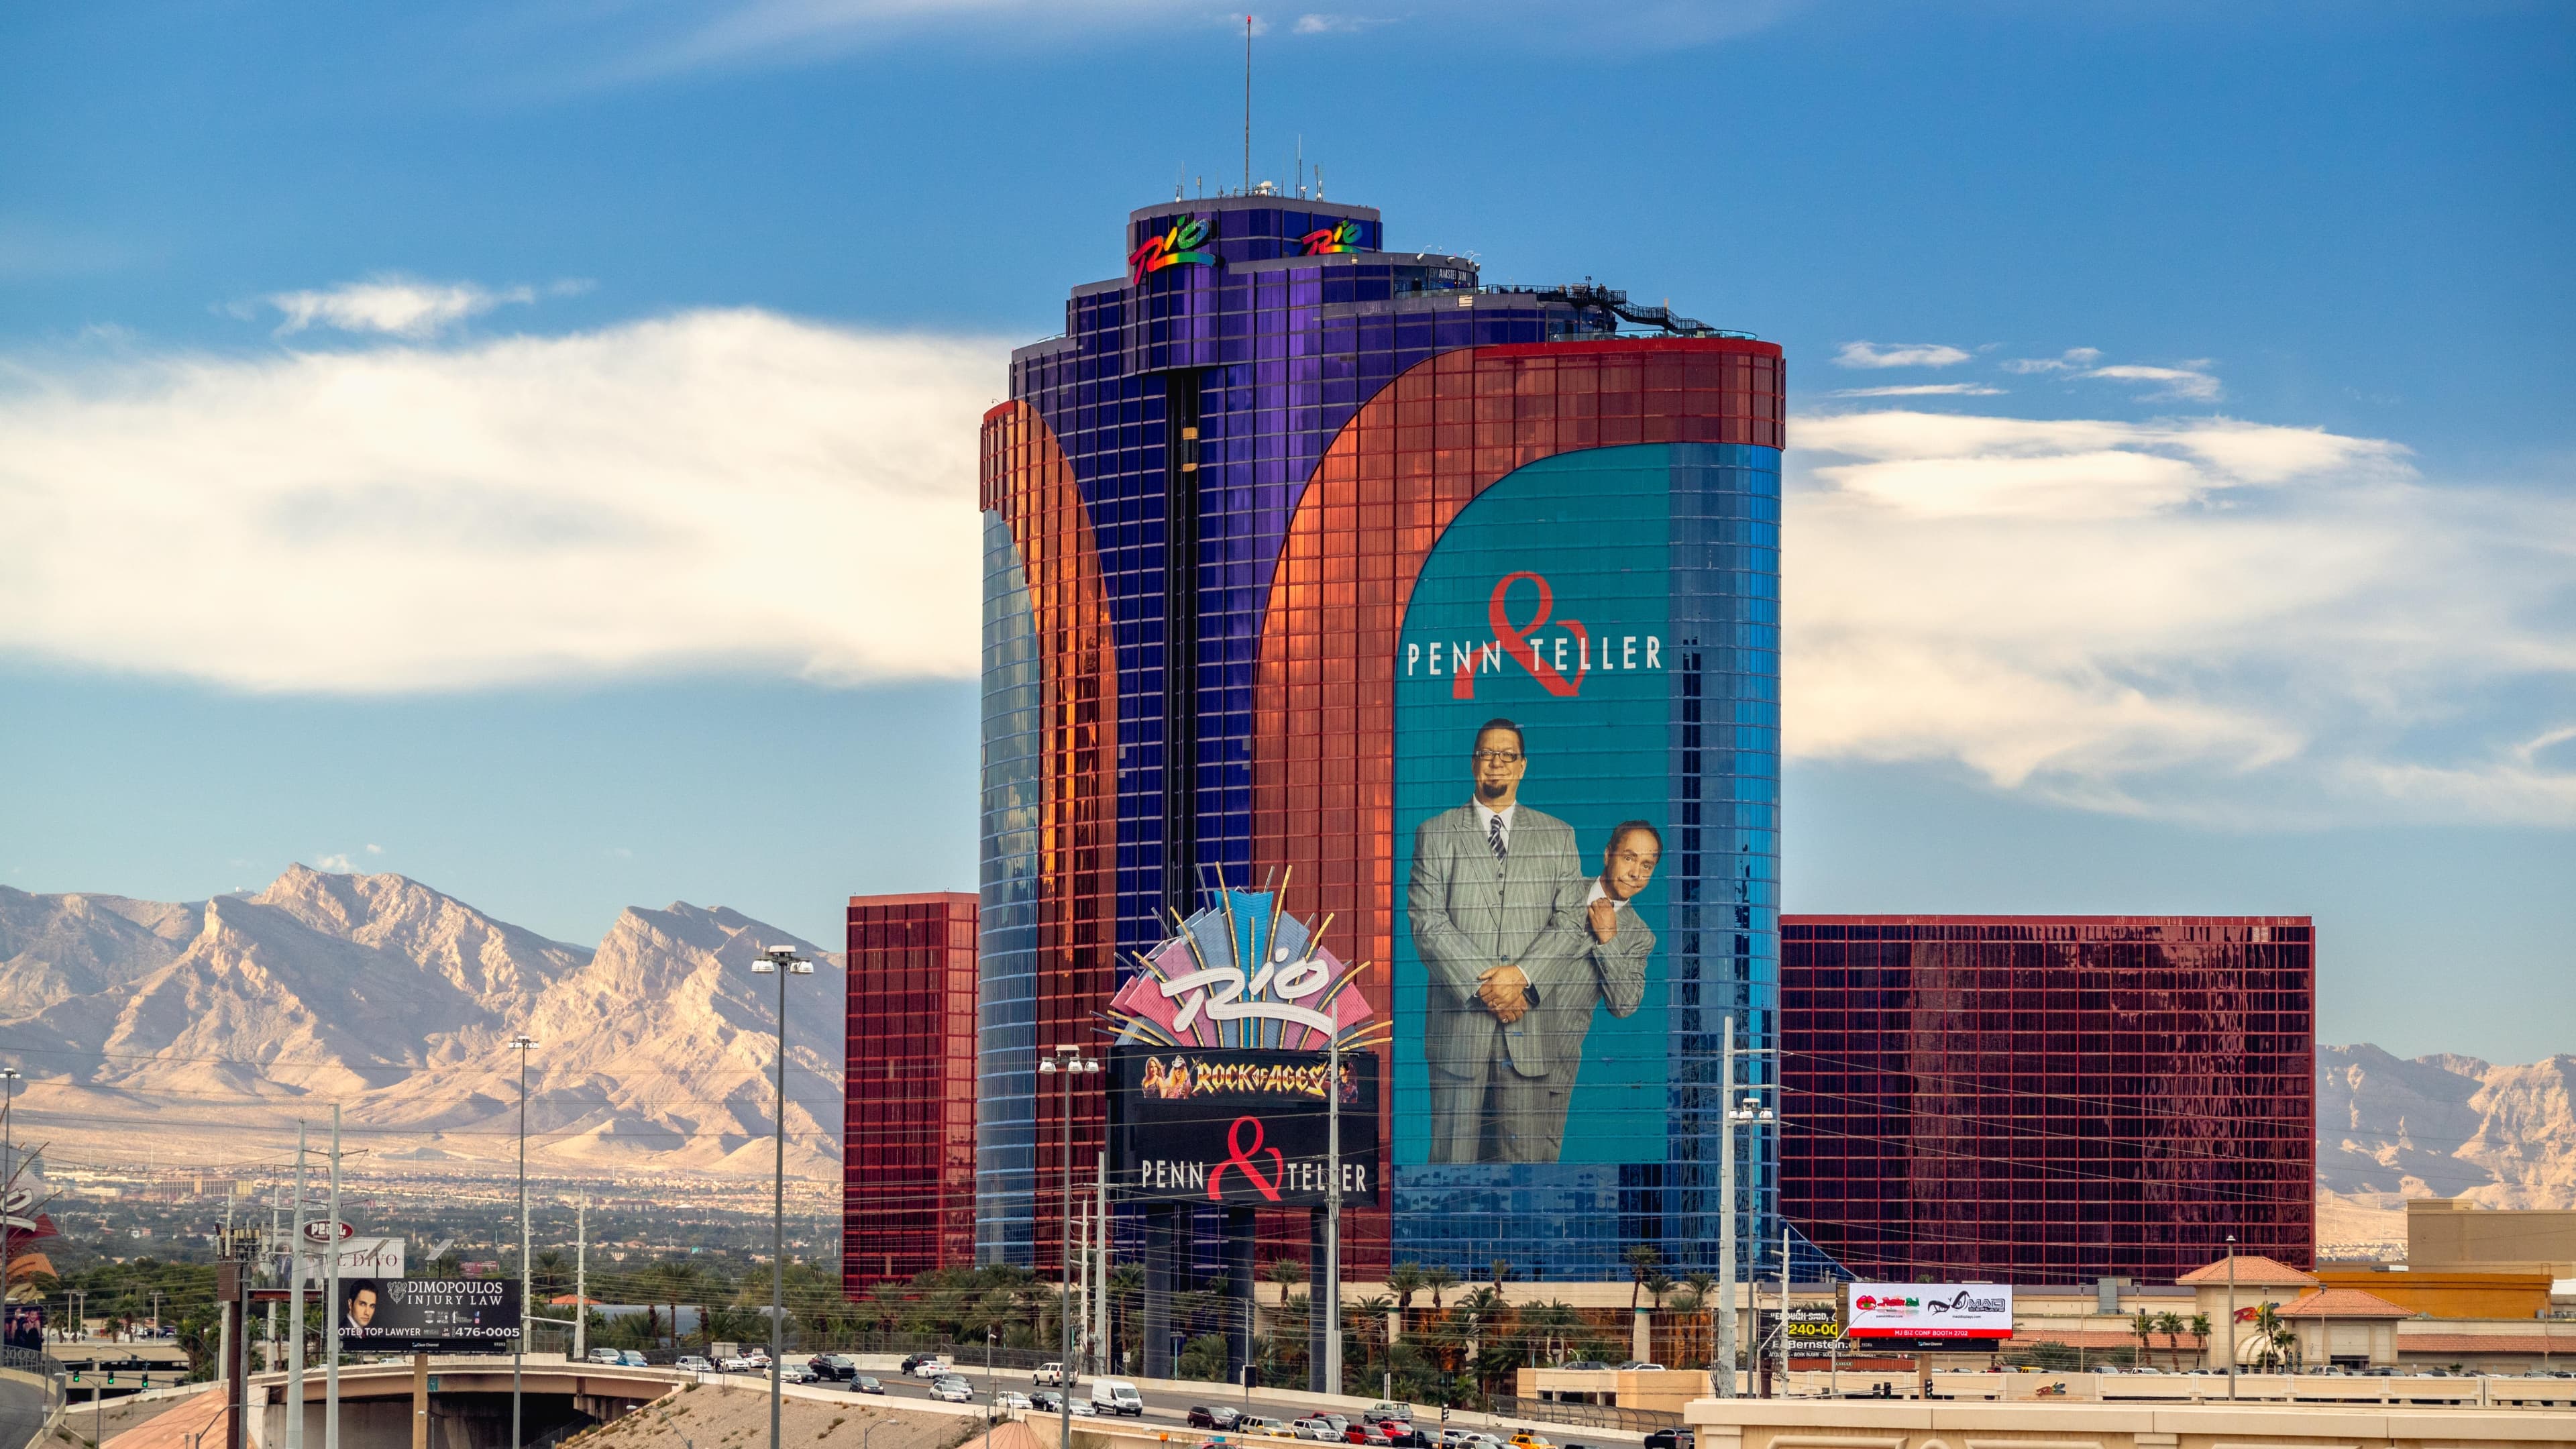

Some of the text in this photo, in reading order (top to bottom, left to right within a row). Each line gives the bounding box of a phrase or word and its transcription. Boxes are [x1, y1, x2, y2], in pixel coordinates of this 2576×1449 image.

[1129, 215, 1216, 285] Rio
[1302, 219, 1363, 256] Rio
[1407, 639, 1501, 676] PENN
[1529, 635, 1662, 671] TELLER
[1159, 947, 1332, 1036] Rio
[1191, 1059, 1328, 1098] ROCK OF AGES
[1142, 1115, 1367, 1201] PENN & TELER
[407, 1281, 503, 1294] DIMOPOULOS
[407, 1295, 503, 1306] INJURY LAW
[337, 1328, 363, 1336] OTED
[365, 1328, 384, 1336] TOP
[385, 1328, 421, 1336] LAWYER
[455, 1328, 520, 1337] 476-0005
